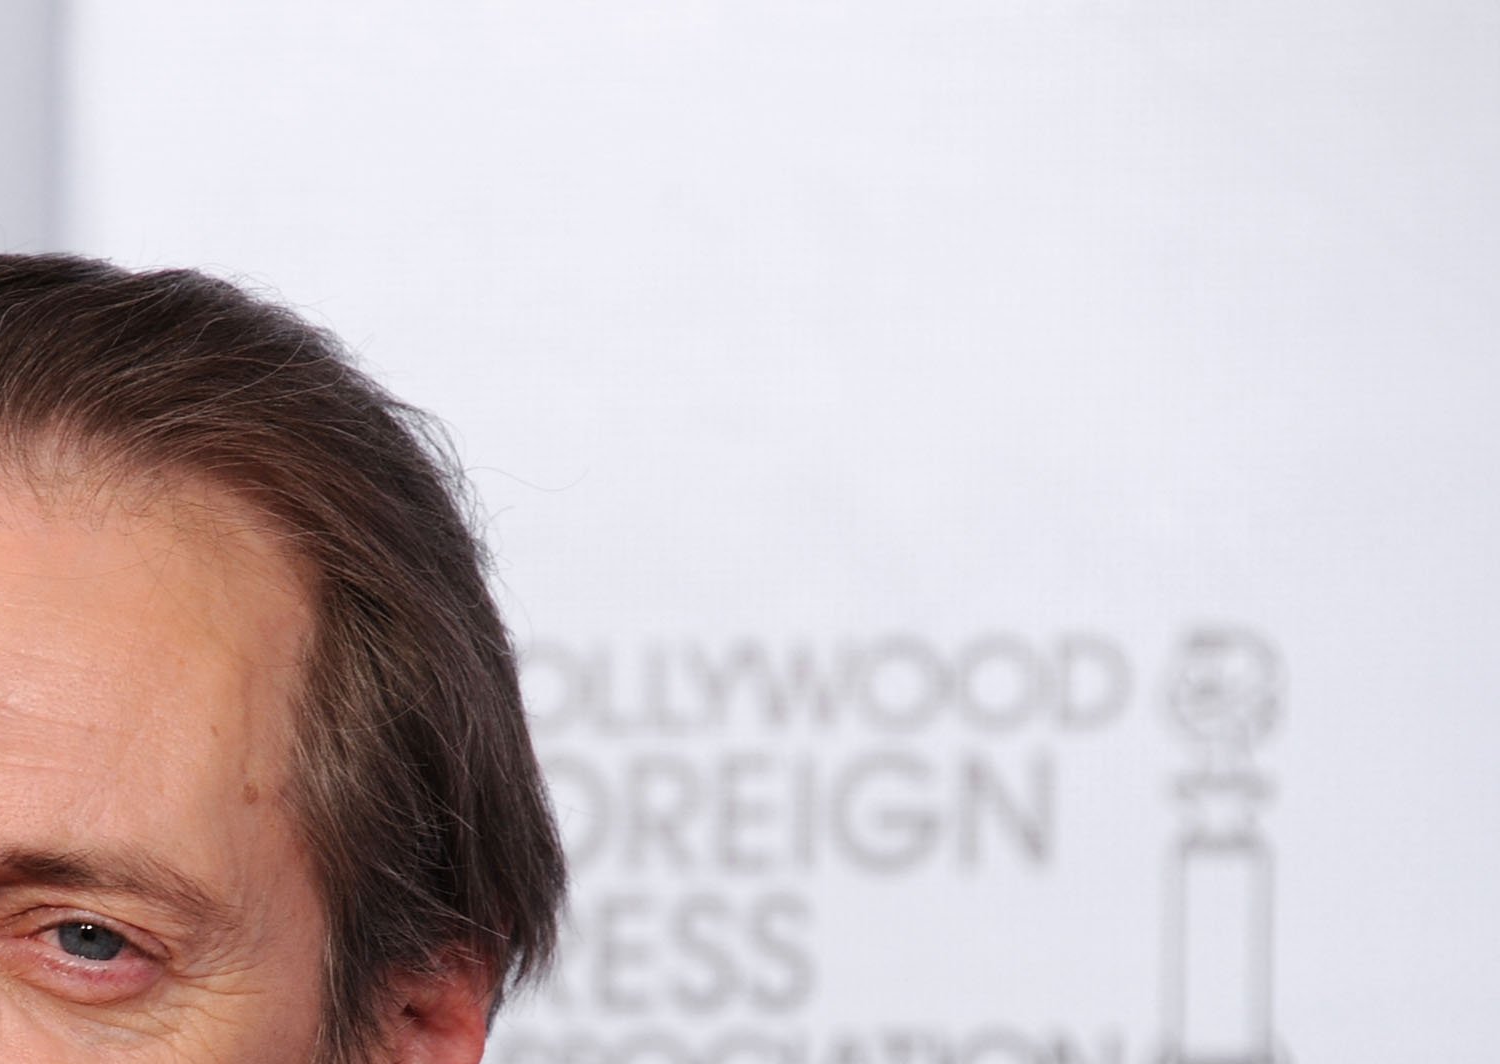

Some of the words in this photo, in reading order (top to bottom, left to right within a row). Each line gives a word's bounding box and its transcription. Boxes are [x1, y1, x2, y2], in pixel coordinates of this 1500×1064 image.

[515, 634, 1134, 738] OLLYWOOD
[540, 749, 1056, 876] OREIGN
[556, 890, 814, 1016] ESS
